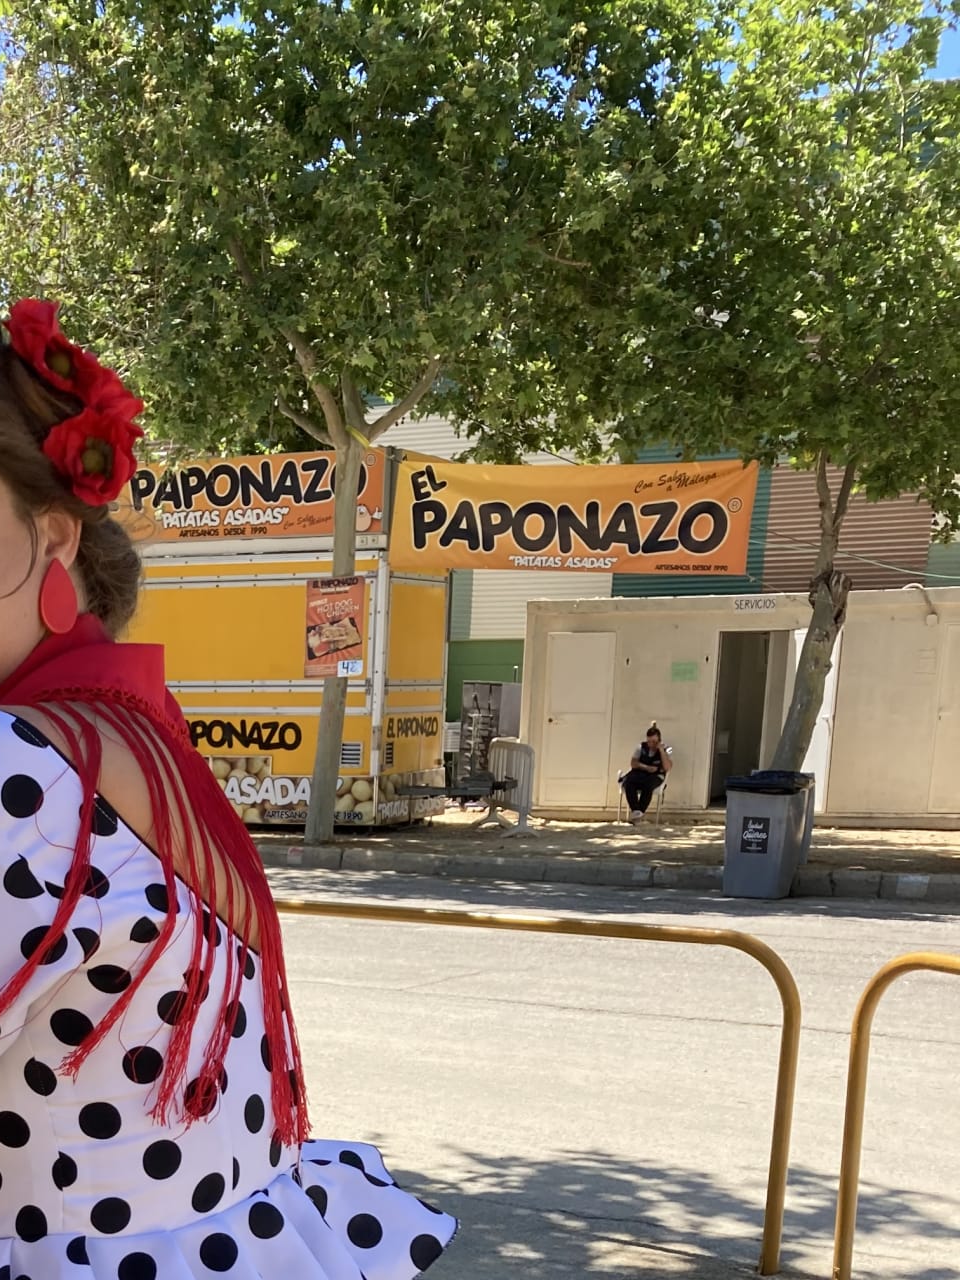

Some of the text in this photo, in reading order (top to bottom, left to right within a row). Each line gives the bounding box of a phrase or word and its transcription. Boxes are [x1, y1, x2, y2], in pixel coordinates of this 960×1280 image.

[411, 465, 447, 501] EL
[634, 480, 654, 494] Con
[179, 526, 267, 537] ARTESANOS DESDE 1990
[412, 499, 728, 555] PAPONAZO
[734, 599, 776, 610] SERVICIOS
[186, 719, 301, 750] PONAZO
[386, 716, 438, 738] EL PAPONAZO
[265, 810, 309, 819] ARTESANO
